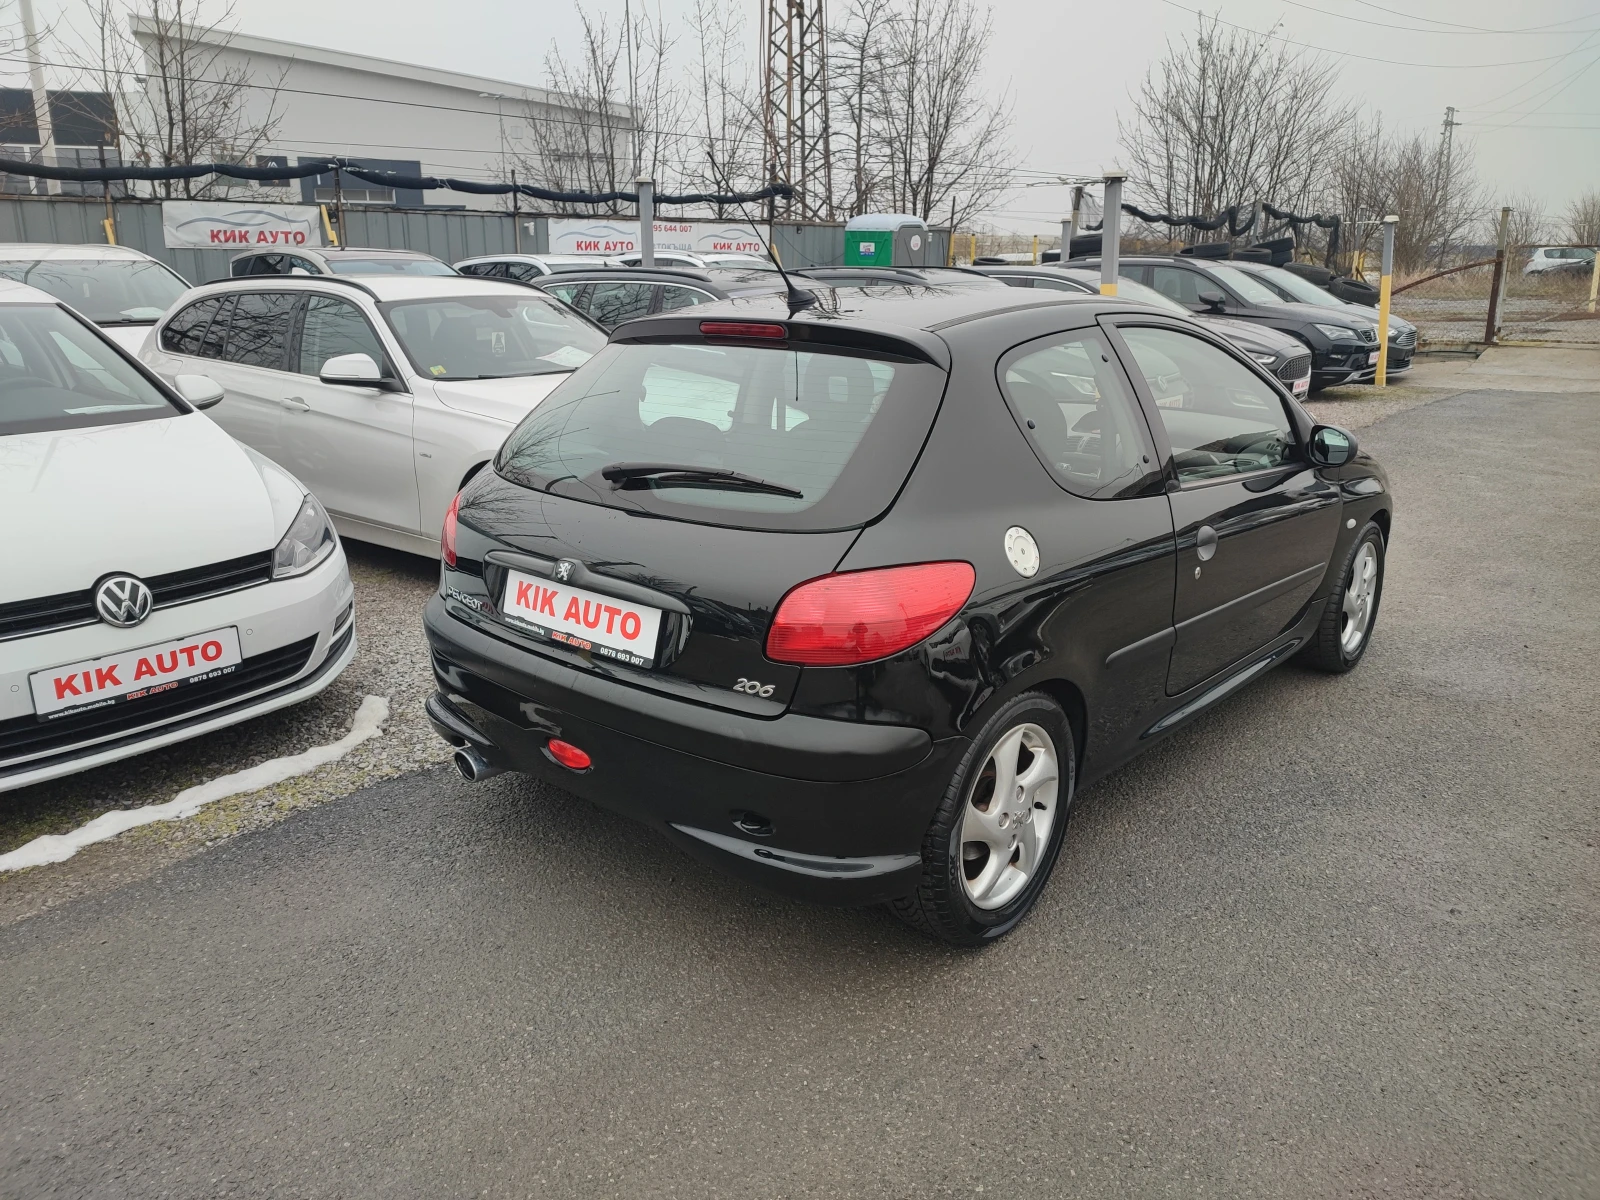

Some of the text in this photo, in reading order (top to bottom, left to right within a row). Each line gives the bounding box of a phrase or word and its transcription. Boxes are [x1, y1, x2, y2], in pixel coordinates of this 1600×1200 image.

[209, 229, 306, 245] КИК АУТО
[663, 225, 677, 233] 644
[679, 225, 692, 233] 007
[576, 240, 634, 252] КИК АУТО
[653, 242, 693, 251] ТОКЪЩА
[713, 242, 760, 252] КИК АУТО
[448, 585, 482, 611] PEUGEOT
[515, 580, 642, 641] KIK AUTO
[551, 631, 568, 643] KIK
[568, 636, 592, 651] AUTO
[617, 652, 630, 662] 693
[630, 656, 644, 666] 007
[53, 640, 223, 700] KIK AUTO
[126, 688, 148, 701] KIK
[148, 681, 179, 695] AUTO
[189, 674, 207, 684] 0878
[222, 666, 236, 674] 007
[732, 677, 776, 698] 206
